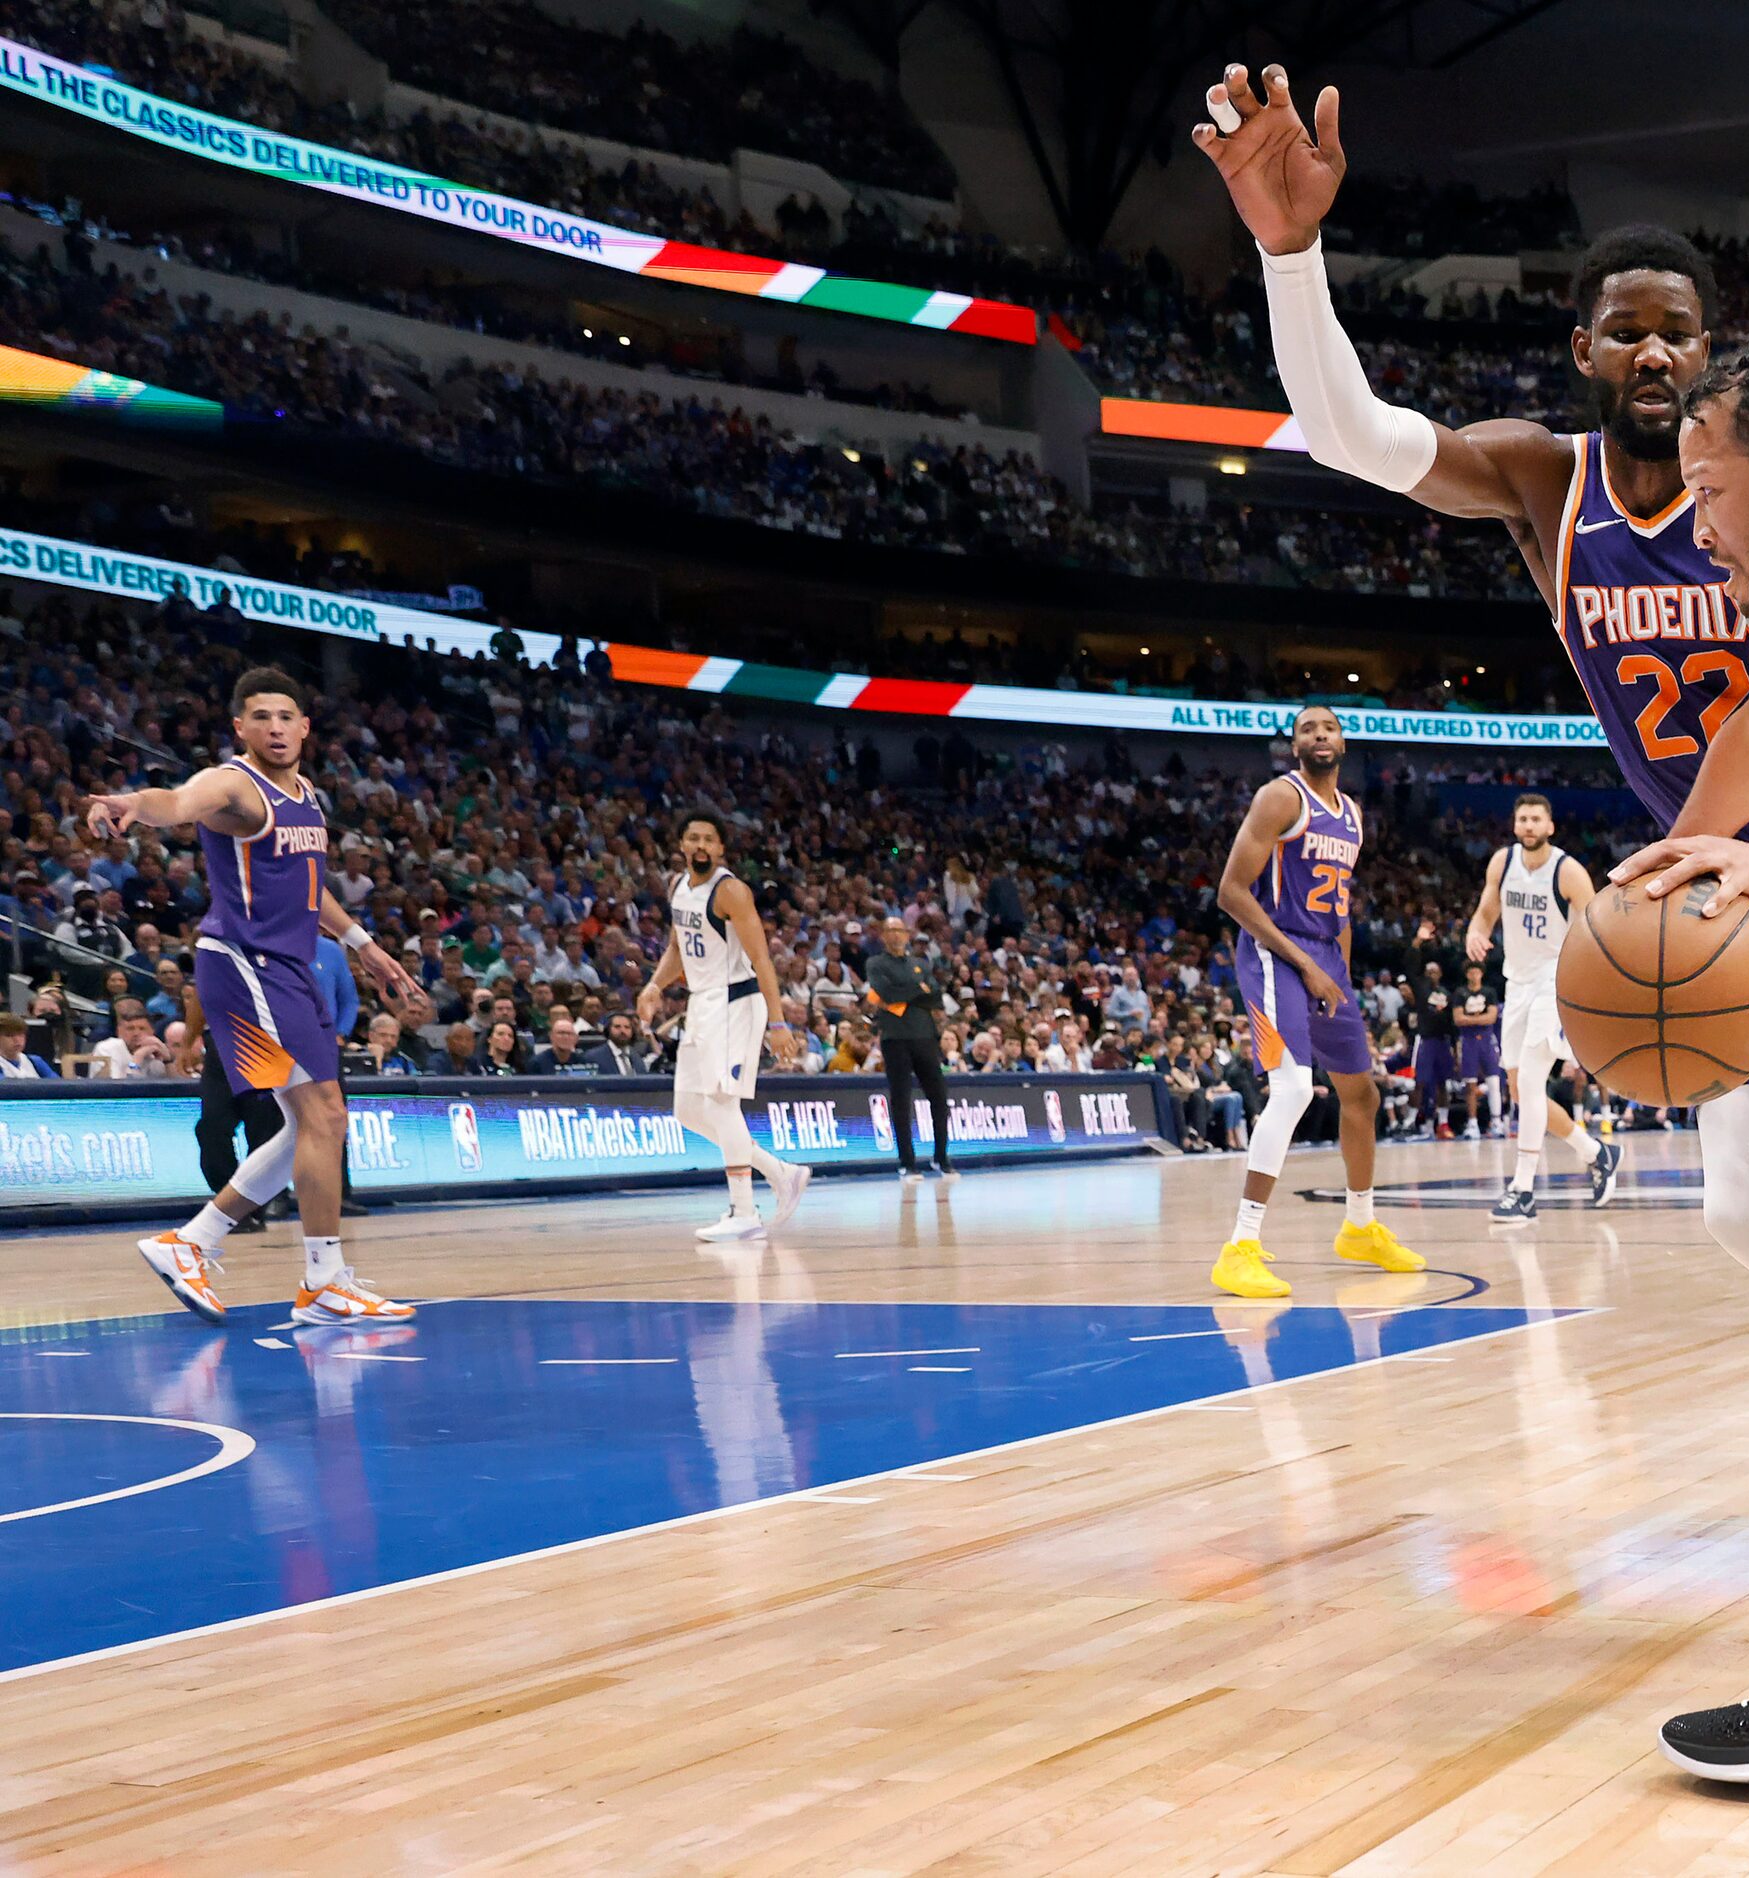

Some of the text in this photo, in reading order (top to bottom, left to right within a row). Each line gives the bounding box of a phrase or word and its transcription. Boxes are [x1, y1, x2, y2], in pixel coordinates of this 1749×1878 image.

[0, 49, 604, 253] LL THE CLASSICS DELIVERED TO YOUR DOOR
[36, 544, 191, 600] DELIVERED
[234, 582, 305, 620] YOUR
[308, 598, 379, 634] DOOR
[1171, 706, 1209, 727] ALL
[1212, 708, 1253, 729] THE
[1365, 715, 1473, 738] DELIVERED
[1476, 720, 1502, 739] TO
[1506, 720, 1561, 741] YOUR
[1565, 722, 1606, 741] DOO
[306, 857, 319, 911] 1
[1305, 863, 1352, 917] 25
[1506, 889, 1548, 912] DALLAS
[684, 930, 705, 958] 26
[1522, 913, 1547, 939] 42
[517, 1106, 687, 1162] NBATickets.com
[767, 1100, 848, 1151] BE HERE.
